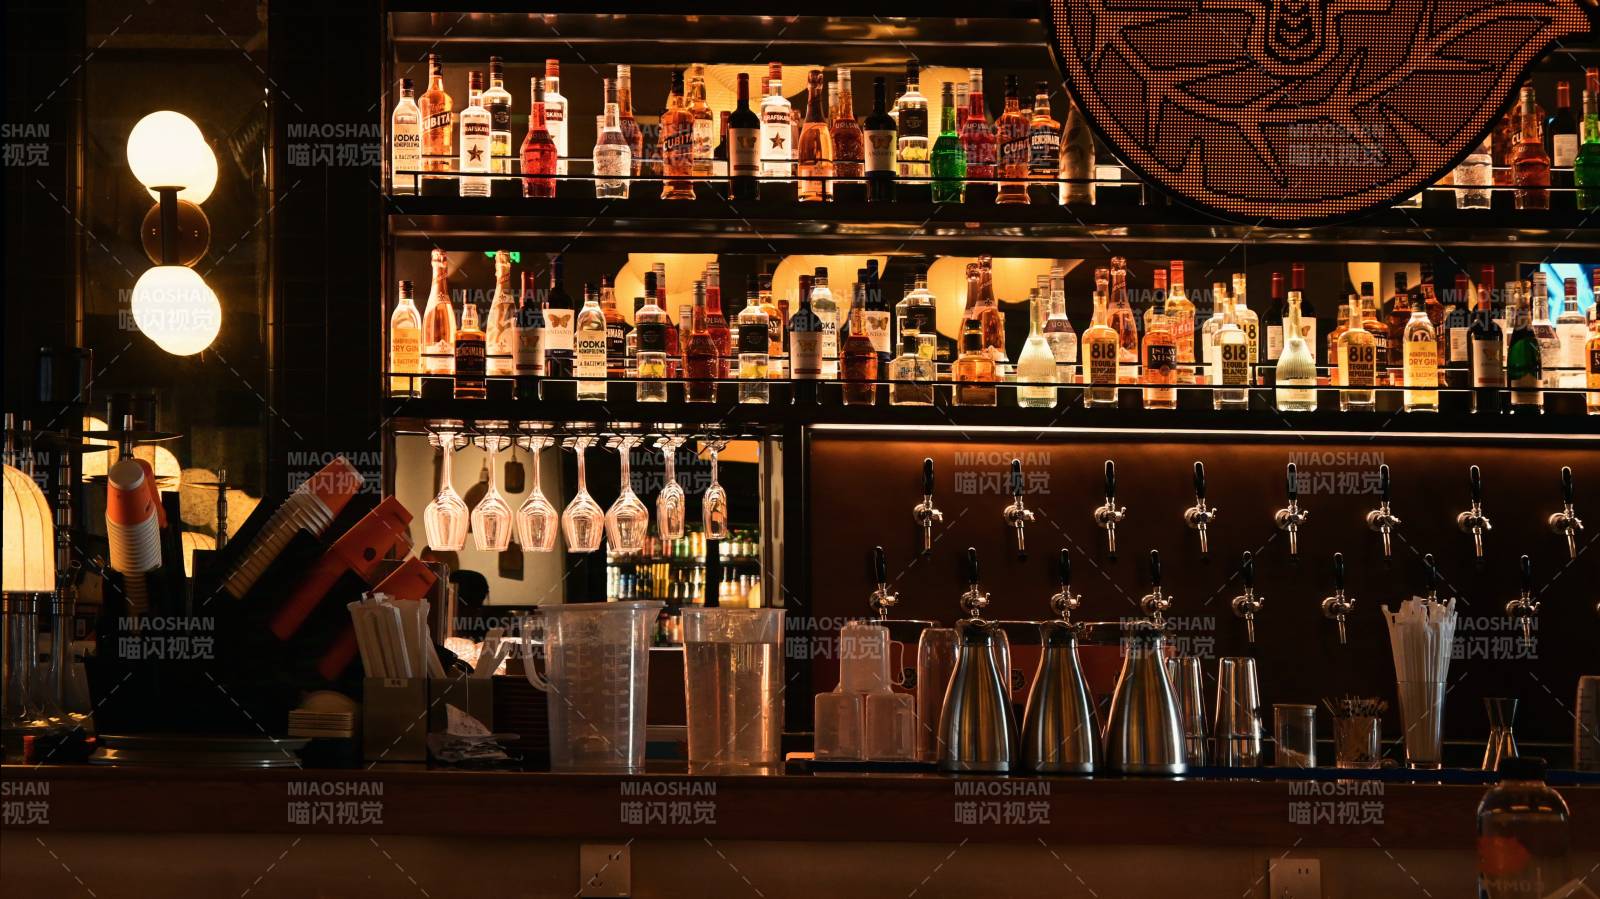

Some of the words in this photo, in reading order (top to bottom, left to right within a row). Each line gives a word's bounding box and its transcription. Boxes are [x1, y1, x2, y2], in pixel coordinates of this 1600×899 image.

[394, 134, 420, 142] VODKA
[1237, 324, 1256, 339] 18
[578, 340, 605, 348] VODKA
[1091, 342, 1115, 359] 818
[1223, 344, 1247, 360] 818
[1349, 346, 1374, 362] 818
